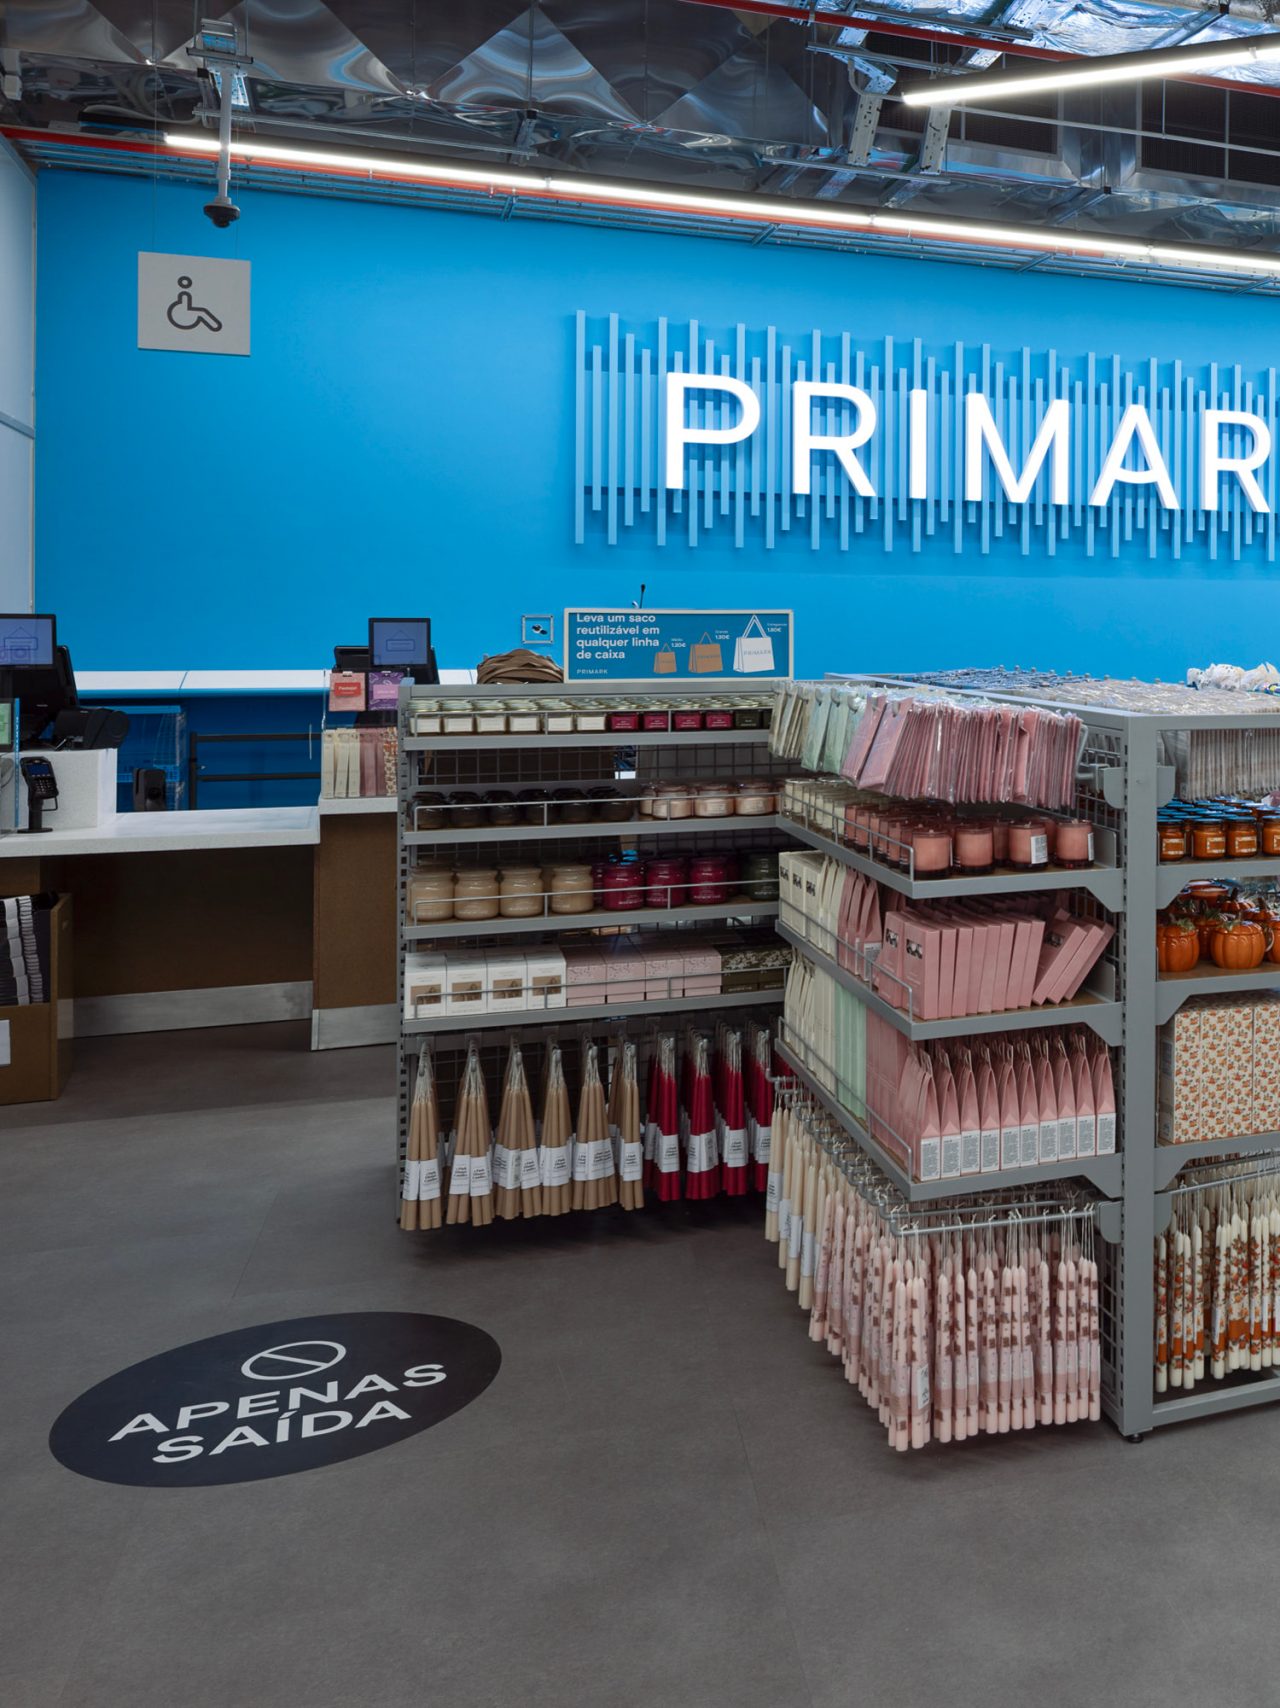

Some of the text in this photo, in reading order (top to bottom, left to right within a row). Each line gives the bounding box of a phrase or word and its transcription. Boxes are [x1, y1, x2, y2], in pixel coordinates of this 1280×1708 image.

[576, 613, 656, 623] Leva um saco
[576, 625, 660, 635] reutilizável em
[576, 637, 660, 649] qualquer linha
[576, 650, 626, 660] de caixa
[107, 1363, 447, 1442] APENAS
[152, 1400, 412, 1464] SAÍDA
